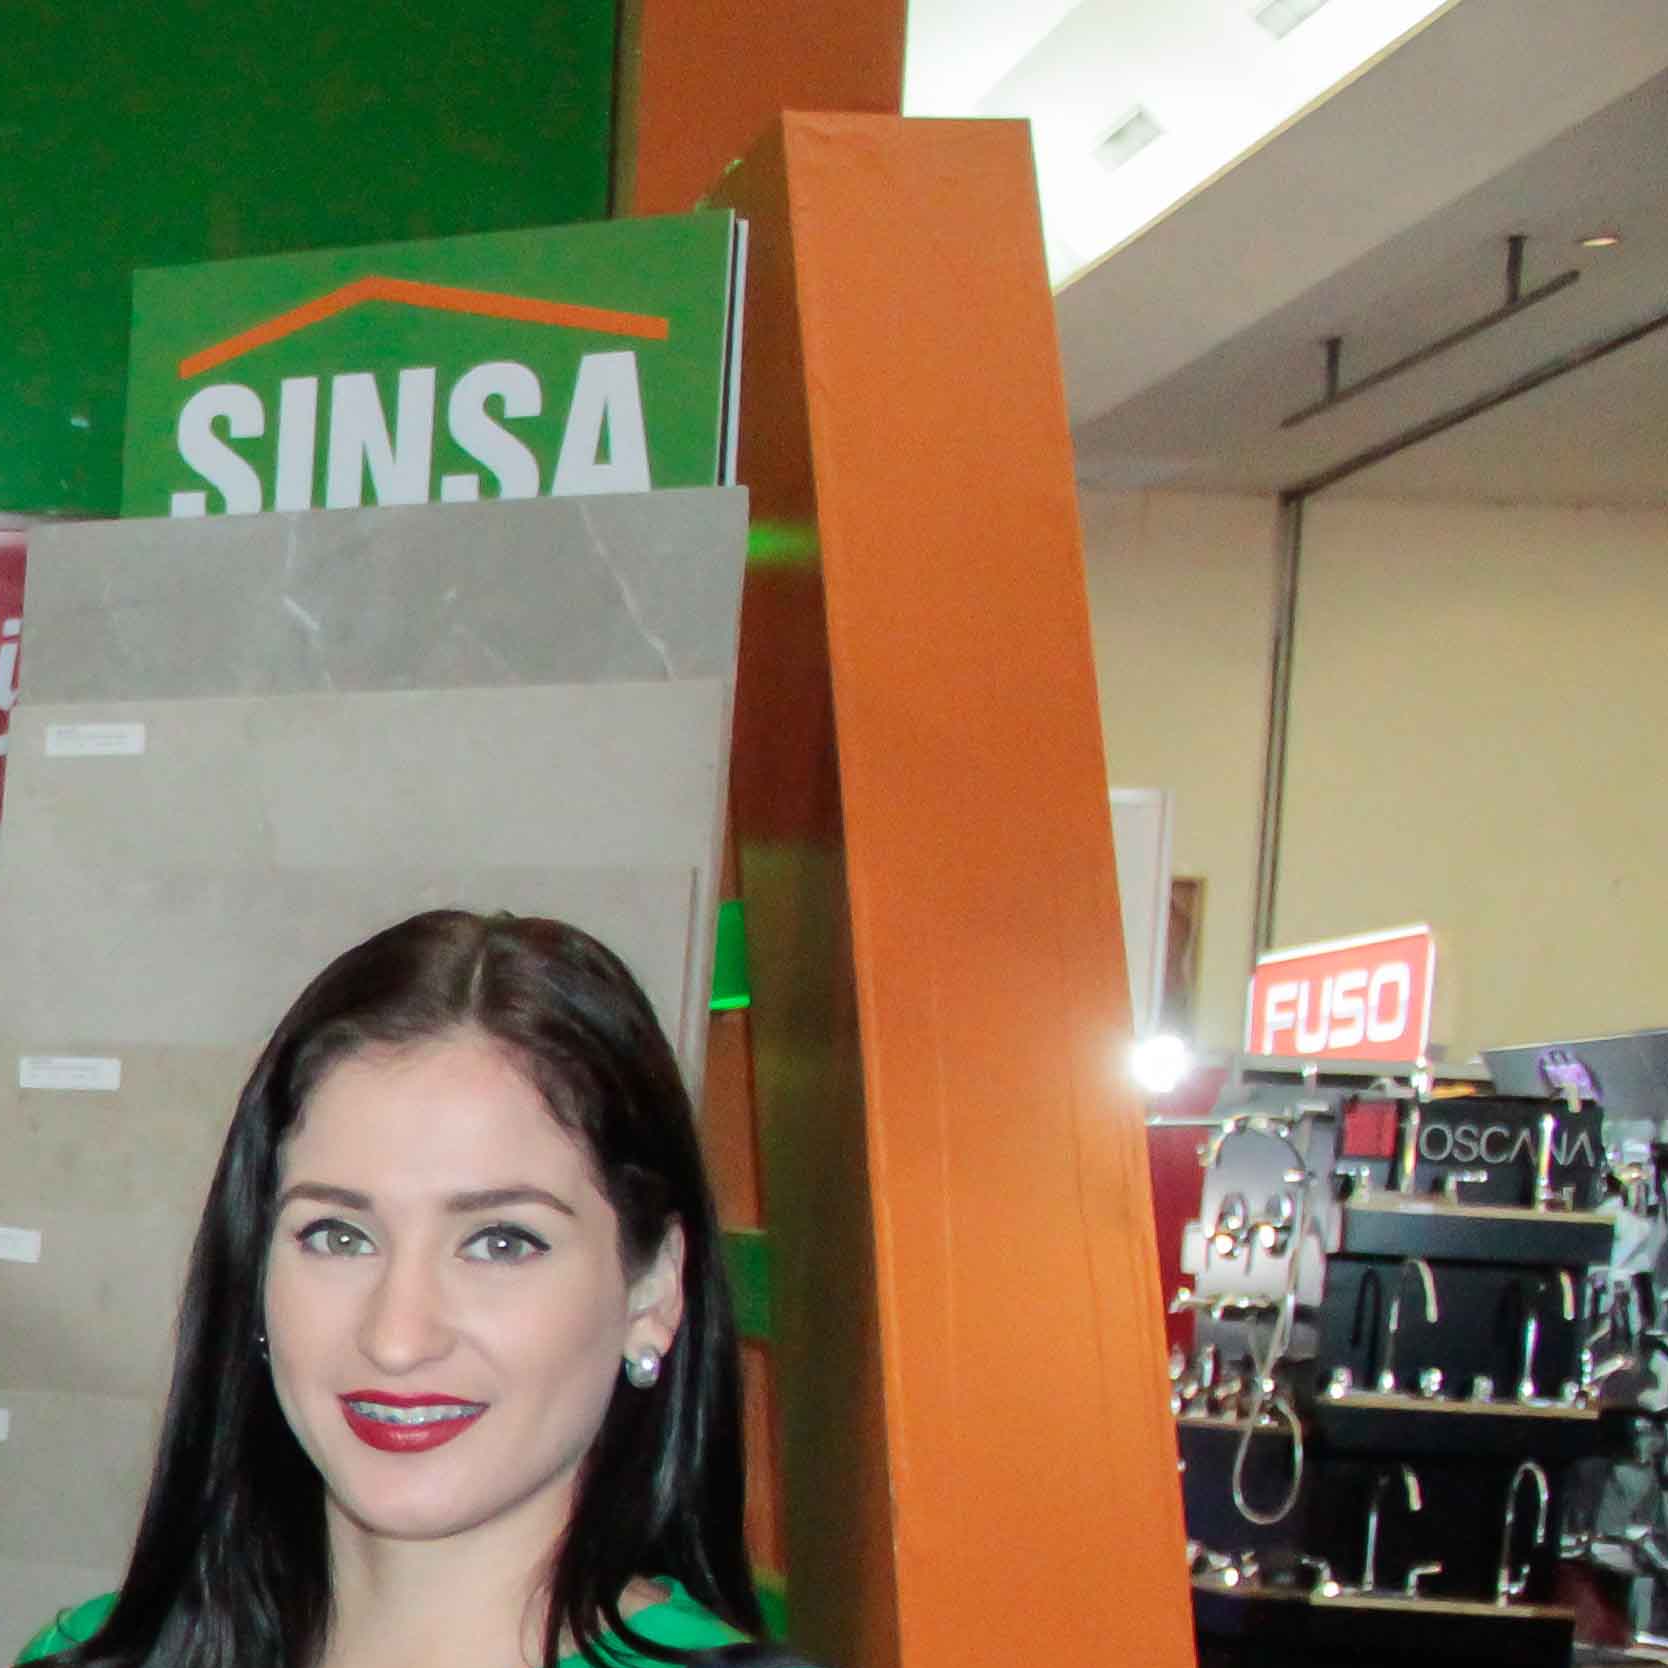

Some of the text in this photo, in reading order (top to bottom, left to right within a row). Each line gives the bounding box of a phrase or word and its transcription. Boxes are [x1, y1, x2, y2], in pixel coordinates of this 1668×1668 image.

[171, 350, 651, 518] SINSA
[1263, 960, 1411, 1056] FUSO
[1419, 1123, 1596, 1169] OSCANA
